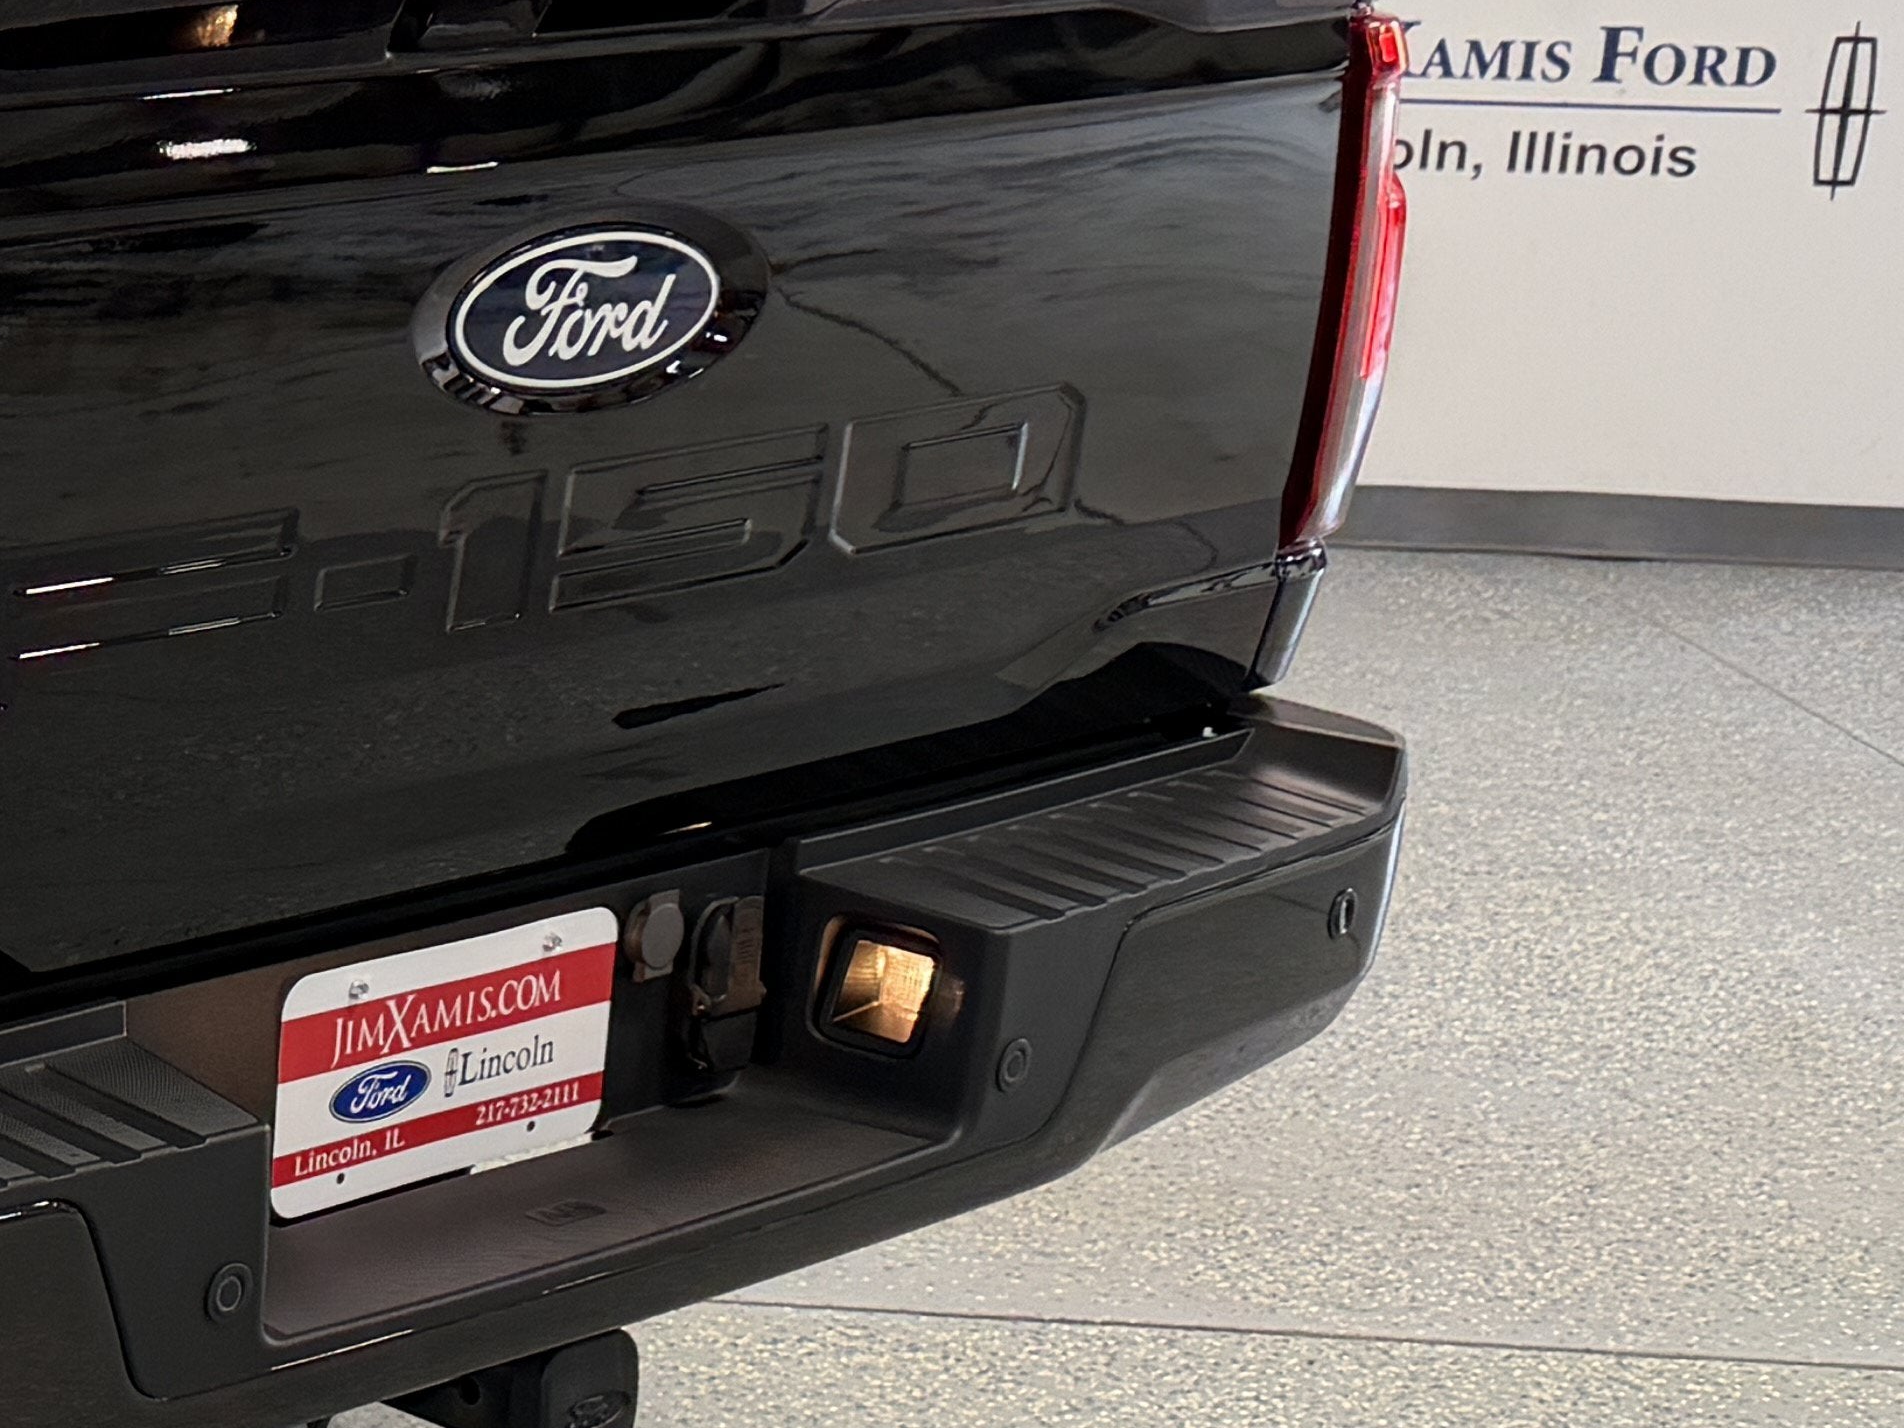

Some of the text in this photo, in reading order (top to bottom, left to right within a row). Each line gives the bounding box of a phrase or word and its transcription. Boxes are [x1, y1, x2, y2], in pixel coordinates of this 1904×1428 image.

[1401, 19, 1572, 83] AMIS
[1505, 129, 1697, 178] Illinois
[502, 254, 677, 367] Ford
[459, 1034, 555, 1087] Lincoln
[349, 1070, 410, 1115] Ford
[474, 1080, 581, 1128] 217-732-2111
[383, 1127, 406, 1151] IL
